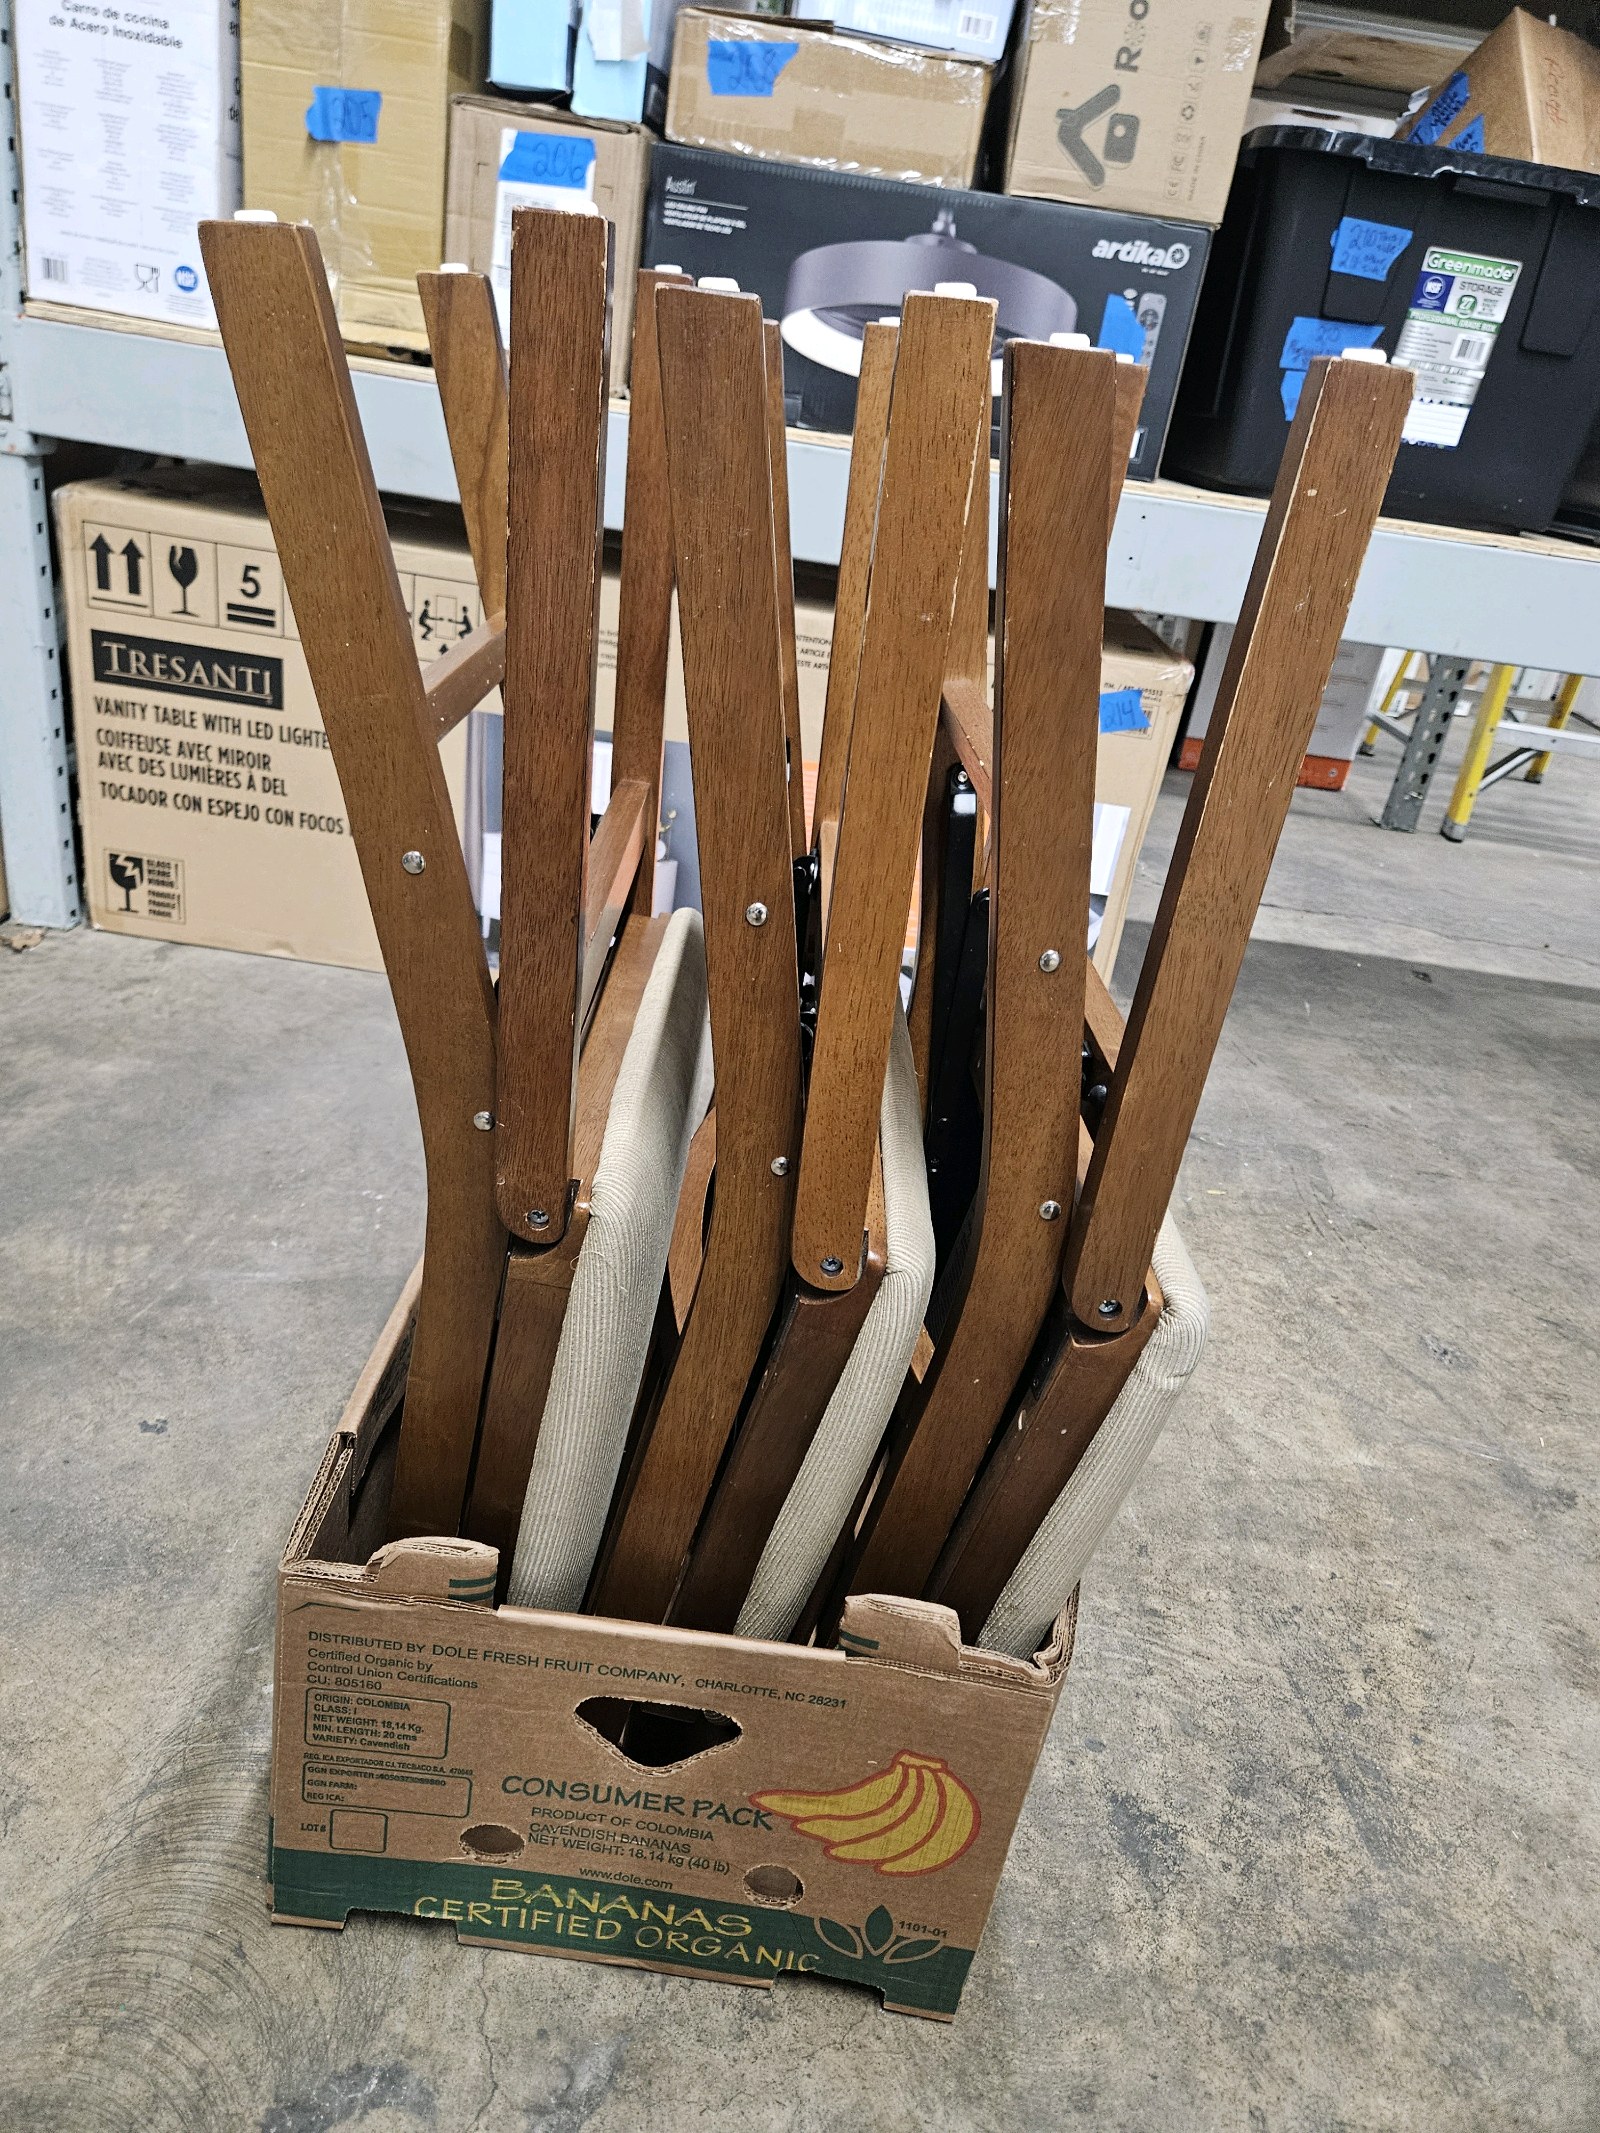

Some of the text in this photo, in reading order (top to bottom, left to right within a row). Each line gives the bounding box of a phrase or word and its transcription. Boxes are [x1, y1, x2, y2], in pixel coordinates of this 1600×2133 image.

[62, 0, 170, 30] Carro de cocina
[49, 15, 184, 49] de Acero Inoxidable
[532, 142, 586, 182] 206
[1092, 239, 1168, 268] artika
[1428, 253, 1513, 281] Greenmade
[1459, 281, 1505, 297] STORAGE
[240, 565, 260, 598] 5
[94, 696, 148, 720] VANITY
[152, 705, 197, 729] TABLE
[202, 713, 242, 736] WITH
[248, 720, 273, 740] LED
[1103, 699, 1137, 728] 214
[97, 728, 272, 771] COIFFEUSE AVEC MIROIR
[98, 752, 288, 796] AVEC DES LUMIÈRES À DEL
[99, 782, 168, 807] TOCADOR
[174, 793, 202, 813] CON
[208, 798, 260, 821] ESPEJO
[265, 808, 294, 827] CON
[300, 813, 344, 835] FOCOS
[307, 1661, 478, 1689] Control Union Certifications
[308, 1649, 433, 1673] Certified Organic by
[308, 1631, 847, 1709] DISTRIBUTED BY DOLE FRESH FRUIT COMPANY, CHARLOTTE, NC 28231
[306, 1674, 331, 1686] CU:
[314, 1693, 411, 1711] ORIGIN: COLOMBIA
[314, 1704, 350, 1715] CLASS:
[313, 1713, 335, 1723] NET
[336, 1715, 379, 1728] WEIGHT:
[408, 1723, 424, 1734] Kg.
[313, 1723, 417, 1741] MIN. LENGTH: 20 cms
[312, 1733, 410, 1751] VARIETY: Cavendish
[307, 1766, 327, 1775] GGN
[329, 1768, 375, 1779] EXPORTER
[322, 1754, 334, 1762] ICA
[336, 1755, 385, 1767] EXPORTADOR
[307, 1779, 357, 1790] GGN FARM:
[307, 1792, 345, 1802] REG ICA:
[501, 1775, 774, 1831] CONSUMER PACK
[301, 1823, 318, 1832] LOT
[531, 1806, 715, 1841] PRODUCT OF COLOMBIA
[530, 1822, 692, 1854] CAVENDISH BANANAS
[528, 1832, 731, 1875] NET WEIGHT: 18.14 kg (40 lb)
[579, 1866, 673, 1890] www.dole.com
[490, 1878, 752, 1937] BANANAS
[414, 1897, 822, 1971] CERTIFIED ORGANIC
[899, 1920, 948, 1938] 1101-01
